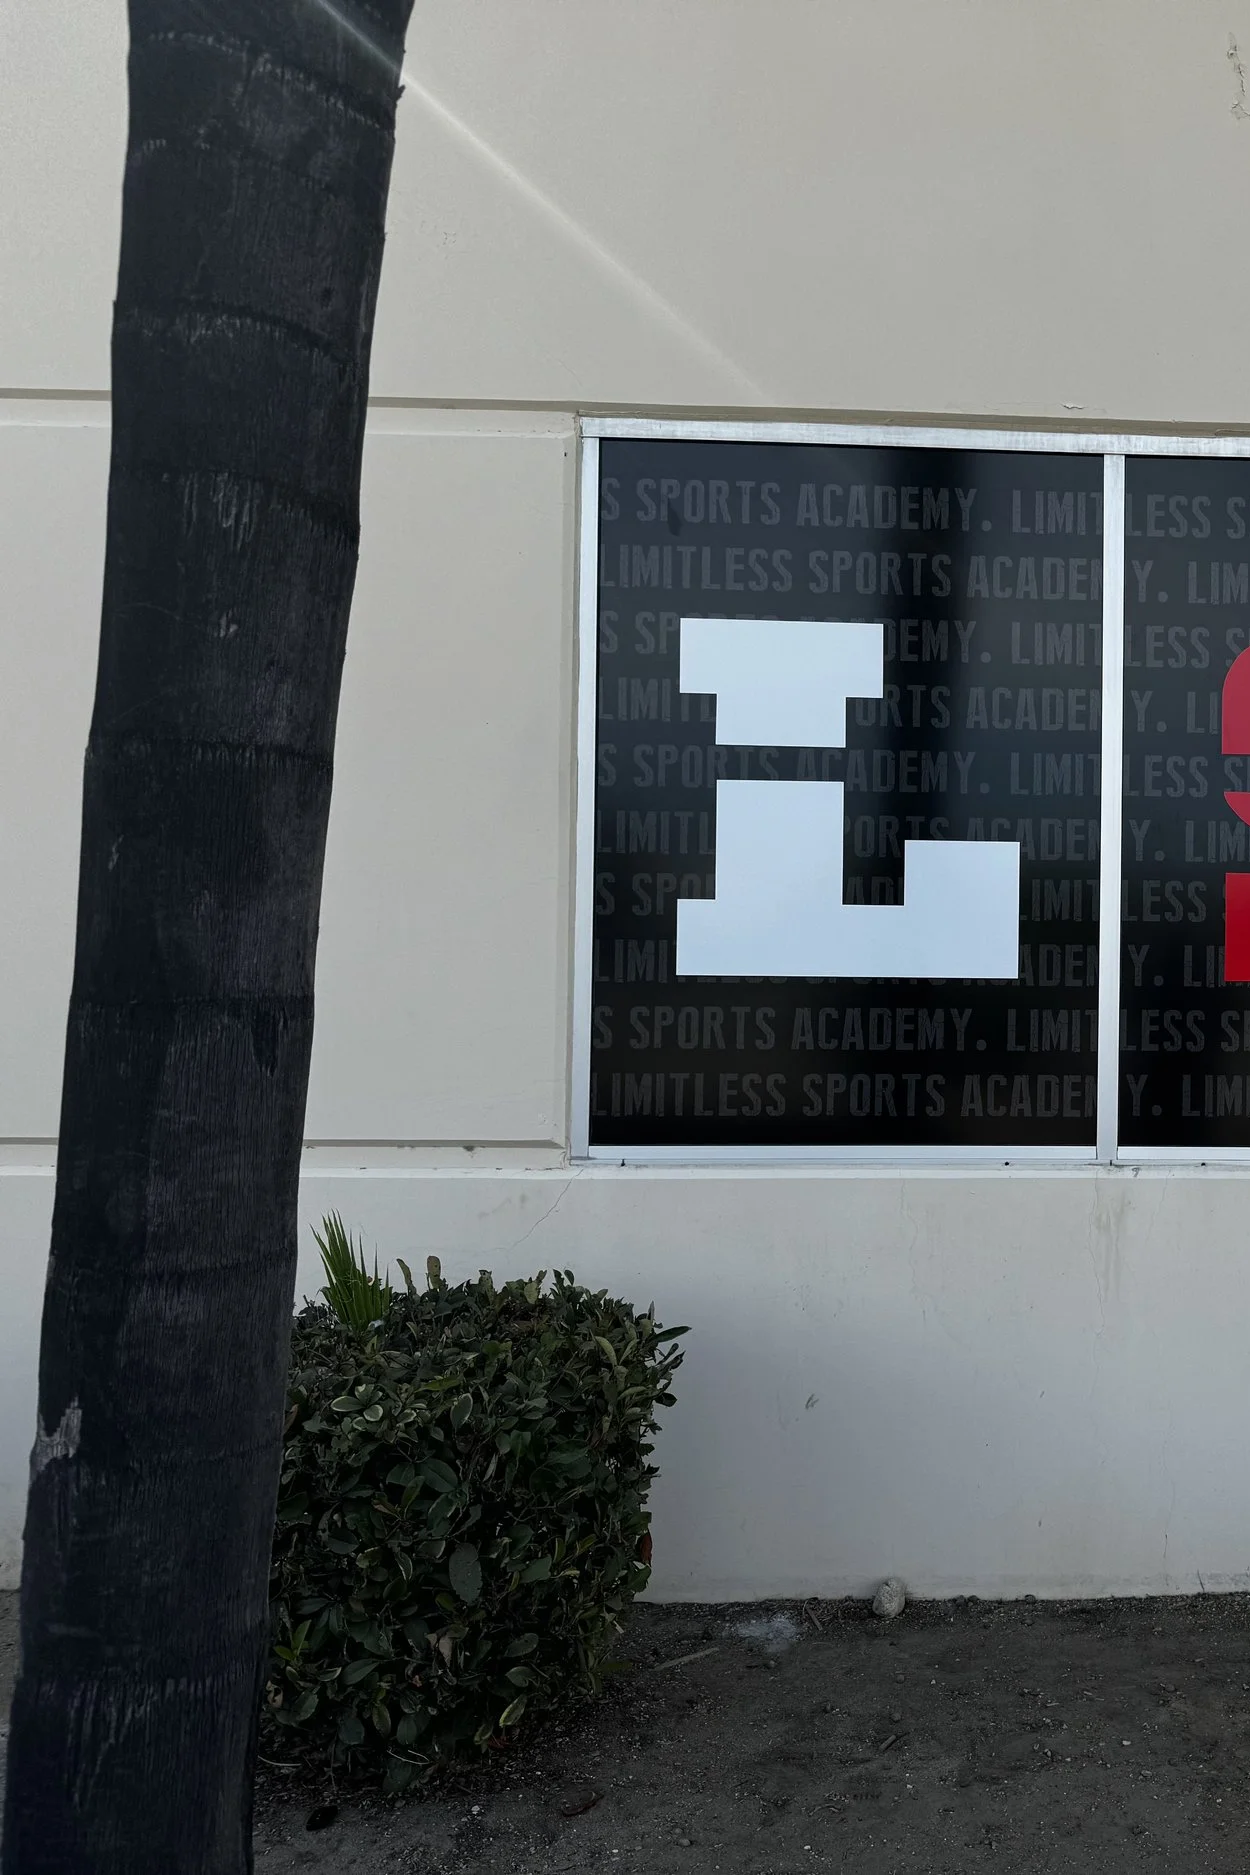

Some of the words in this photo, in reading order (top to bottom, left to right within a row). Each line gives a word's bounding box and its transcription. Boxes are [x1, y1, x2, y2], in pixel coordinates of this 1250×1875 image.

[636, 478, 781, 525] SPORTS
[796, 482, 993, 532] ACADEMY.
[600, 544, 793, 592] LIMITLESS
[809, 550, 951, 597] SPORTS
[854, 683, 950, 727] ORTS
[632, 744, 778, 788] SPORTS
[596, 809, 715, 854] LIMITL
[629, 1006, 776, 1050] SPORTS
[791, 1007, 987, 1051] ACADEMY.
[591, 1072, 787, 1117] LIMITLESS
[802, 1073, 946, 1117] SPORTS
